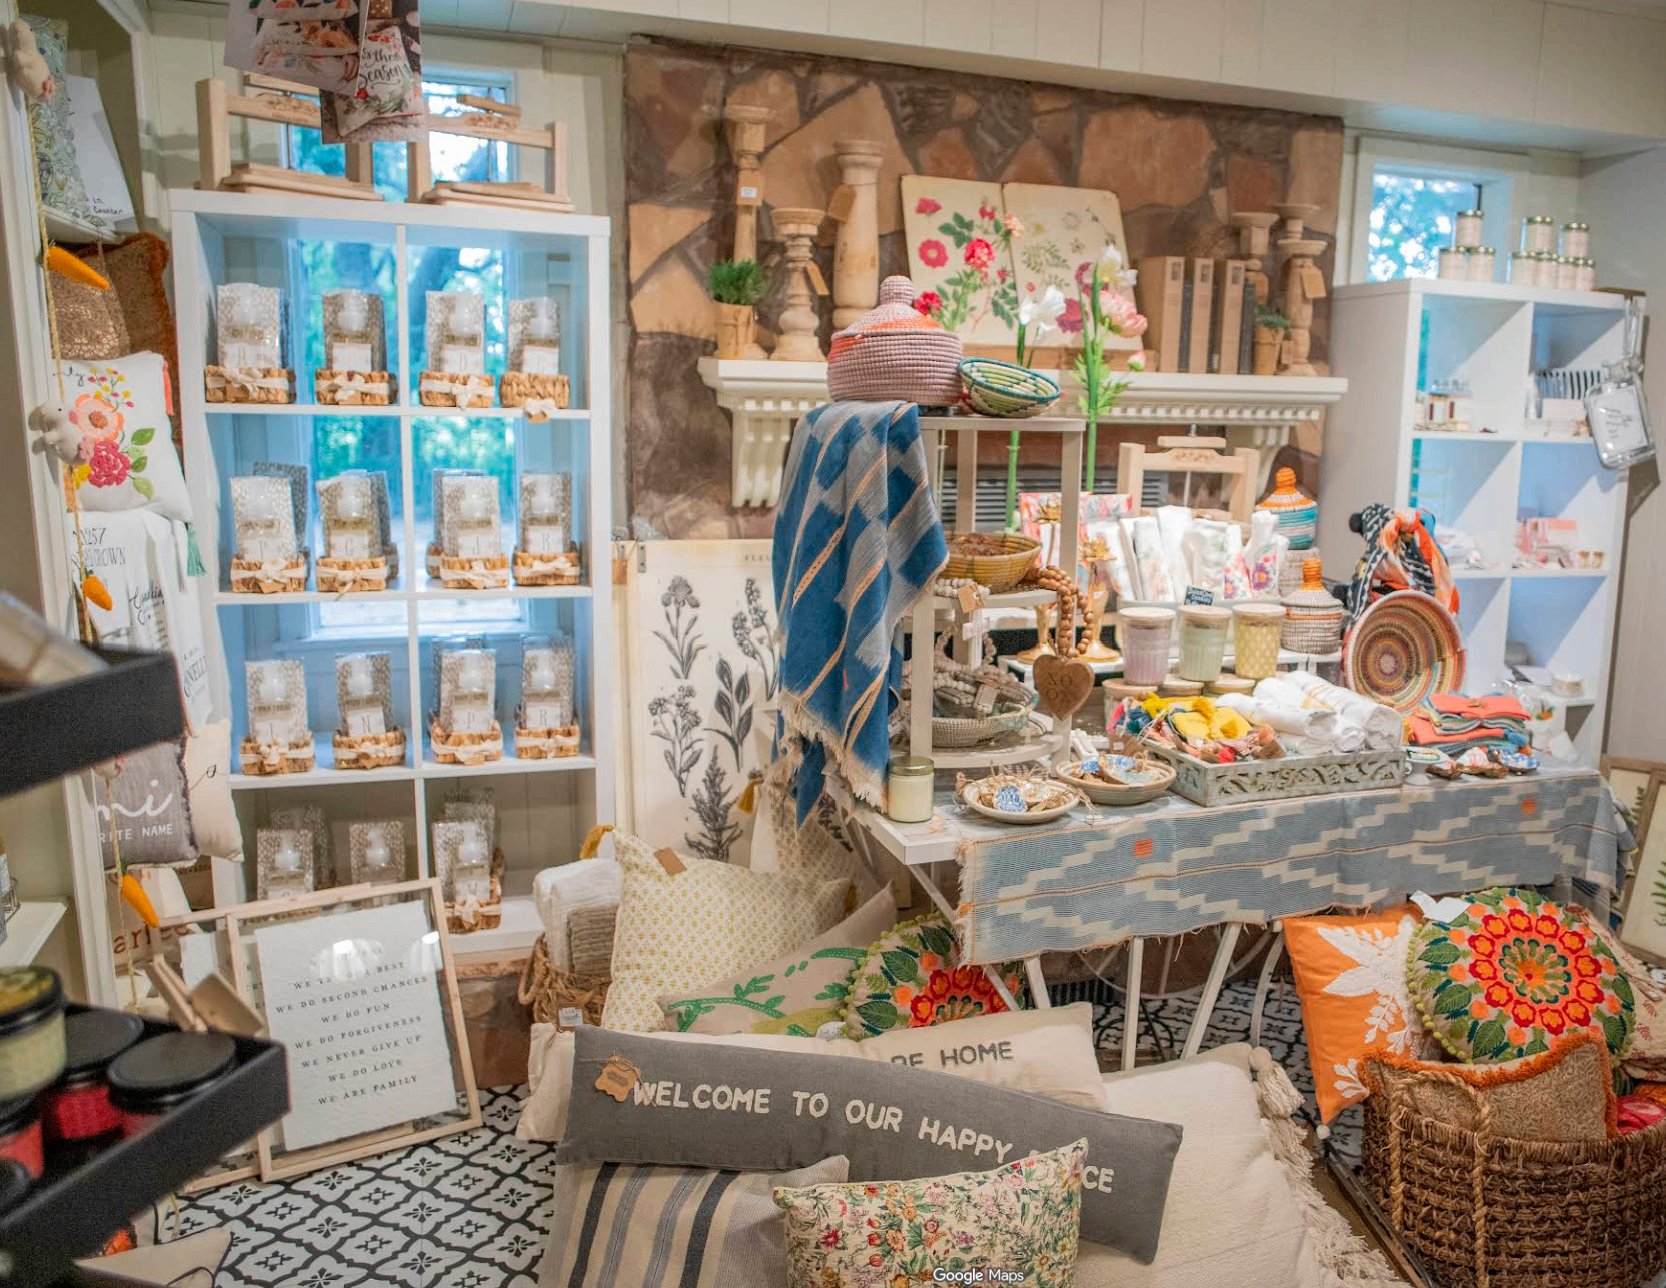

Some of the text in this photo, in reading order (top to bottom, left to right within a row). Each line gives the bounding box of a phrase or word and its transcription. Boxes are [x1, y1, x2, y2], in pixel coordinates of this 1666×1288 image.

[142, 823, 174, 838] NAME
[377, 962, 404, 974] BEST
[276, 976, 427, 1013] WE DO SECOND CHANCES
[321, 1003, 390, 1023] WE DO FUN
[295, 1016, 422, 1049] WE DO FORGIVENESS
[301, 1035, 421, 1068] WE NEVER GIVE UP
[939, 1040, 1015, 1068] HOME
[329, 1059, 402, 1082] WE DO LOVE
[319, 1075, 418, 1105] WE ARE FAMILY
[633, 1080, 771, 1115] WELCOME
[792, 1090, 829, 1118] TO
[845, 1099, 903, 1133] OUR
[918, 1116, 1014, 1164] HAPPY
